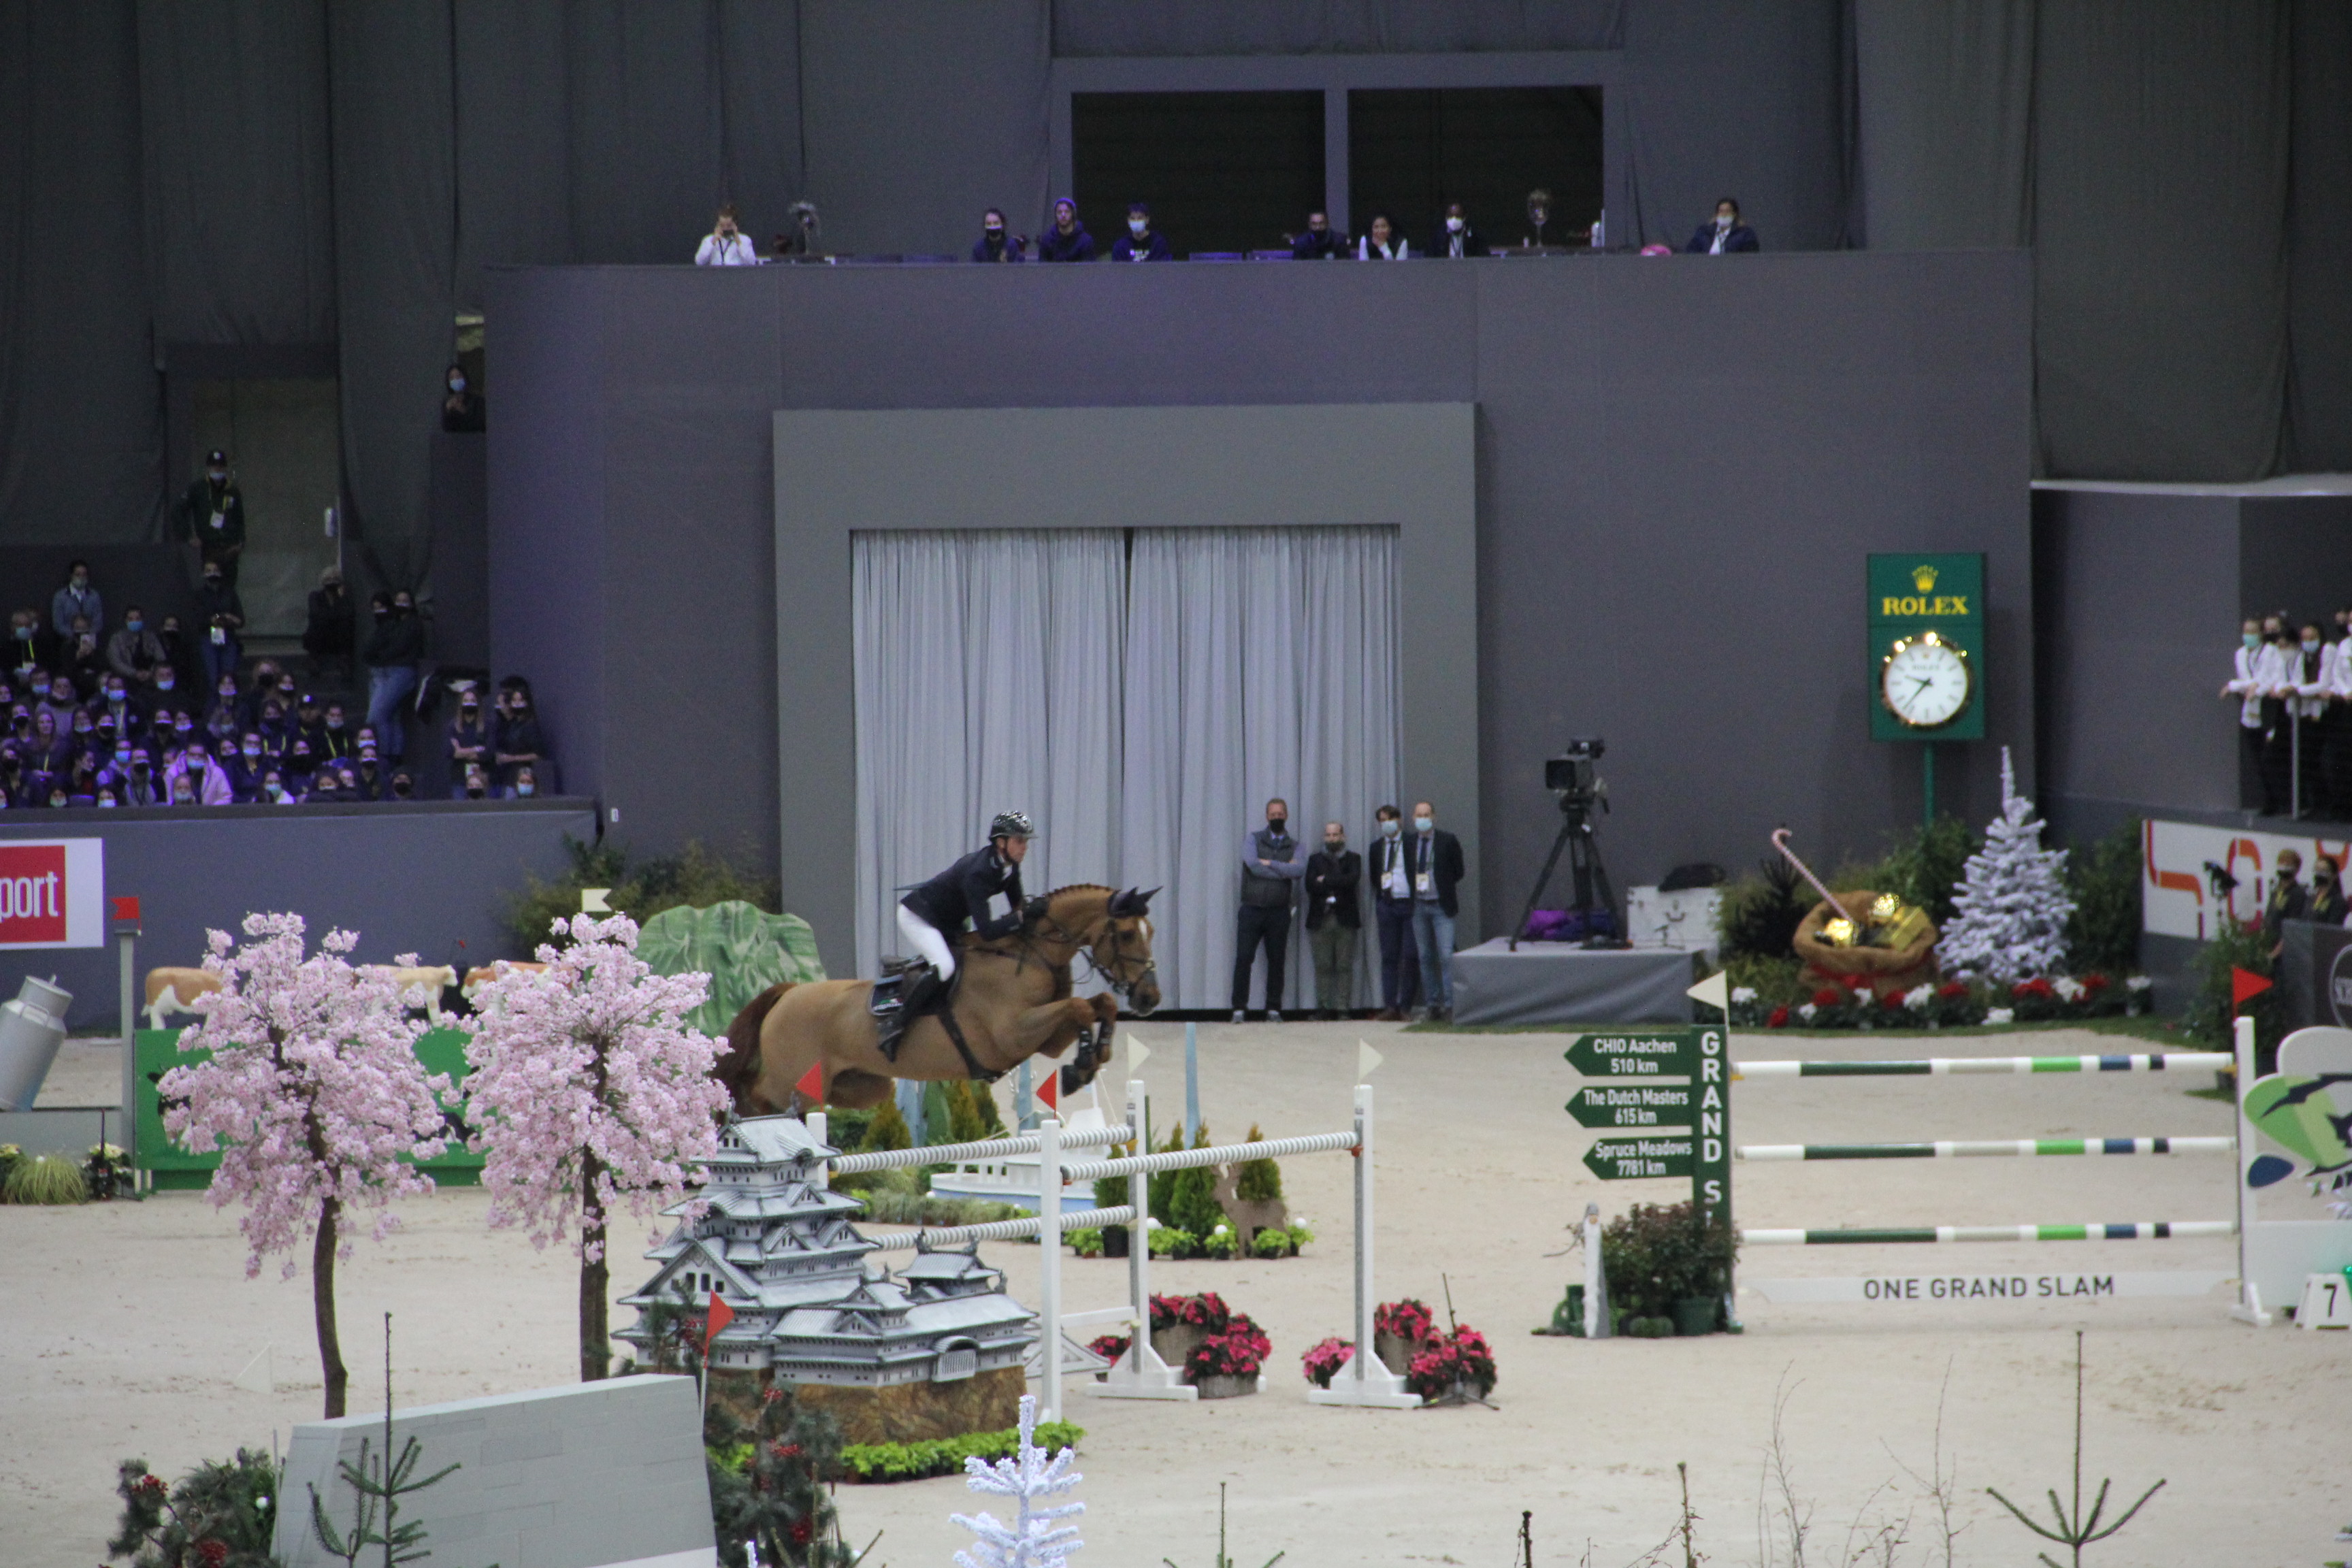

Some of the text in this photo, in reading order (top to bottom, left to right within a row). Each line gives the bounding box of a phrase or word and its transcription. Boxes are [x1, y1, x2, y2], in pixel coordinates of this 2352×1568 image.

[1882, 596, 1970, 615] ROLEX
[1593, 1038, 1677, 1054] CHIO Aachen
[1611, 1058, 1659, 1073] 510 km
[1584, 1088, 1689, 1105] The Dutch Masters
[1701, 1030, 1722, 1163] GRAND
[1615, 1108, 1657, 1124] 615 km
[1595, 1140, 1693, 1161] Spruce Meadows
[1616, 1159, 1666, 1176] 7781 km
[1864, 1275, 2114, 1299] ONE GRAND SLAM
[2323, 1283, 2338, 1318] 7
